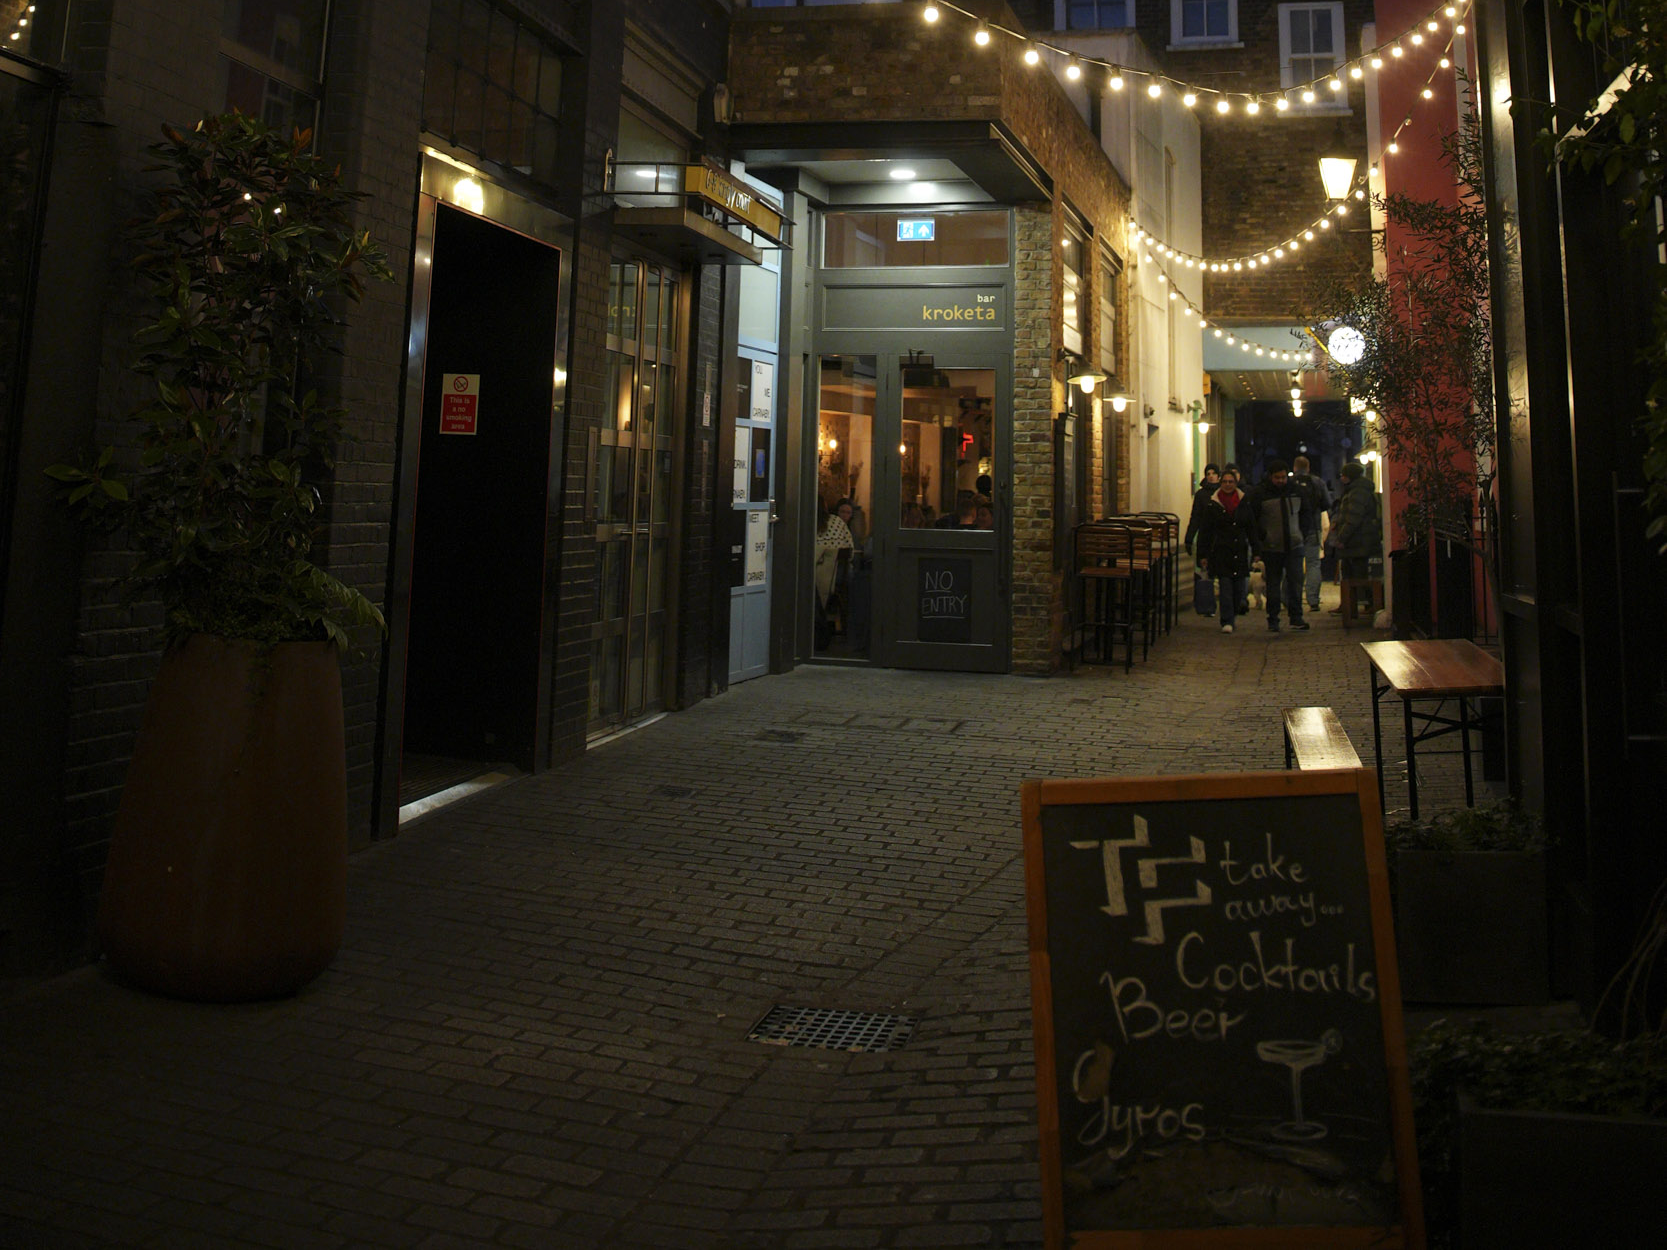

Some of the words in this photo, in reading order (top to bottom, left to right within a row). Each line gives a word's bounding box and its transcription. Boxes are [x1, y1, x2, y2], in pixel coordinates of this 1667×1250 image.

[976, 293, 996, 303] bar
[922, 304, 996, 321] kroketa
[449, 396, 463, 404] This
[464, 396, 471, 404] is
[446, 414, 473, 423] smoking
[924, 570, 954, 591] NO
[921, 594, 968, 615] ENTRY
[1219, 831, 1308, 886] take
[1176, 930, 1378, 1002] Cocktails
[1099, 970, 1248, 1043] Beer
